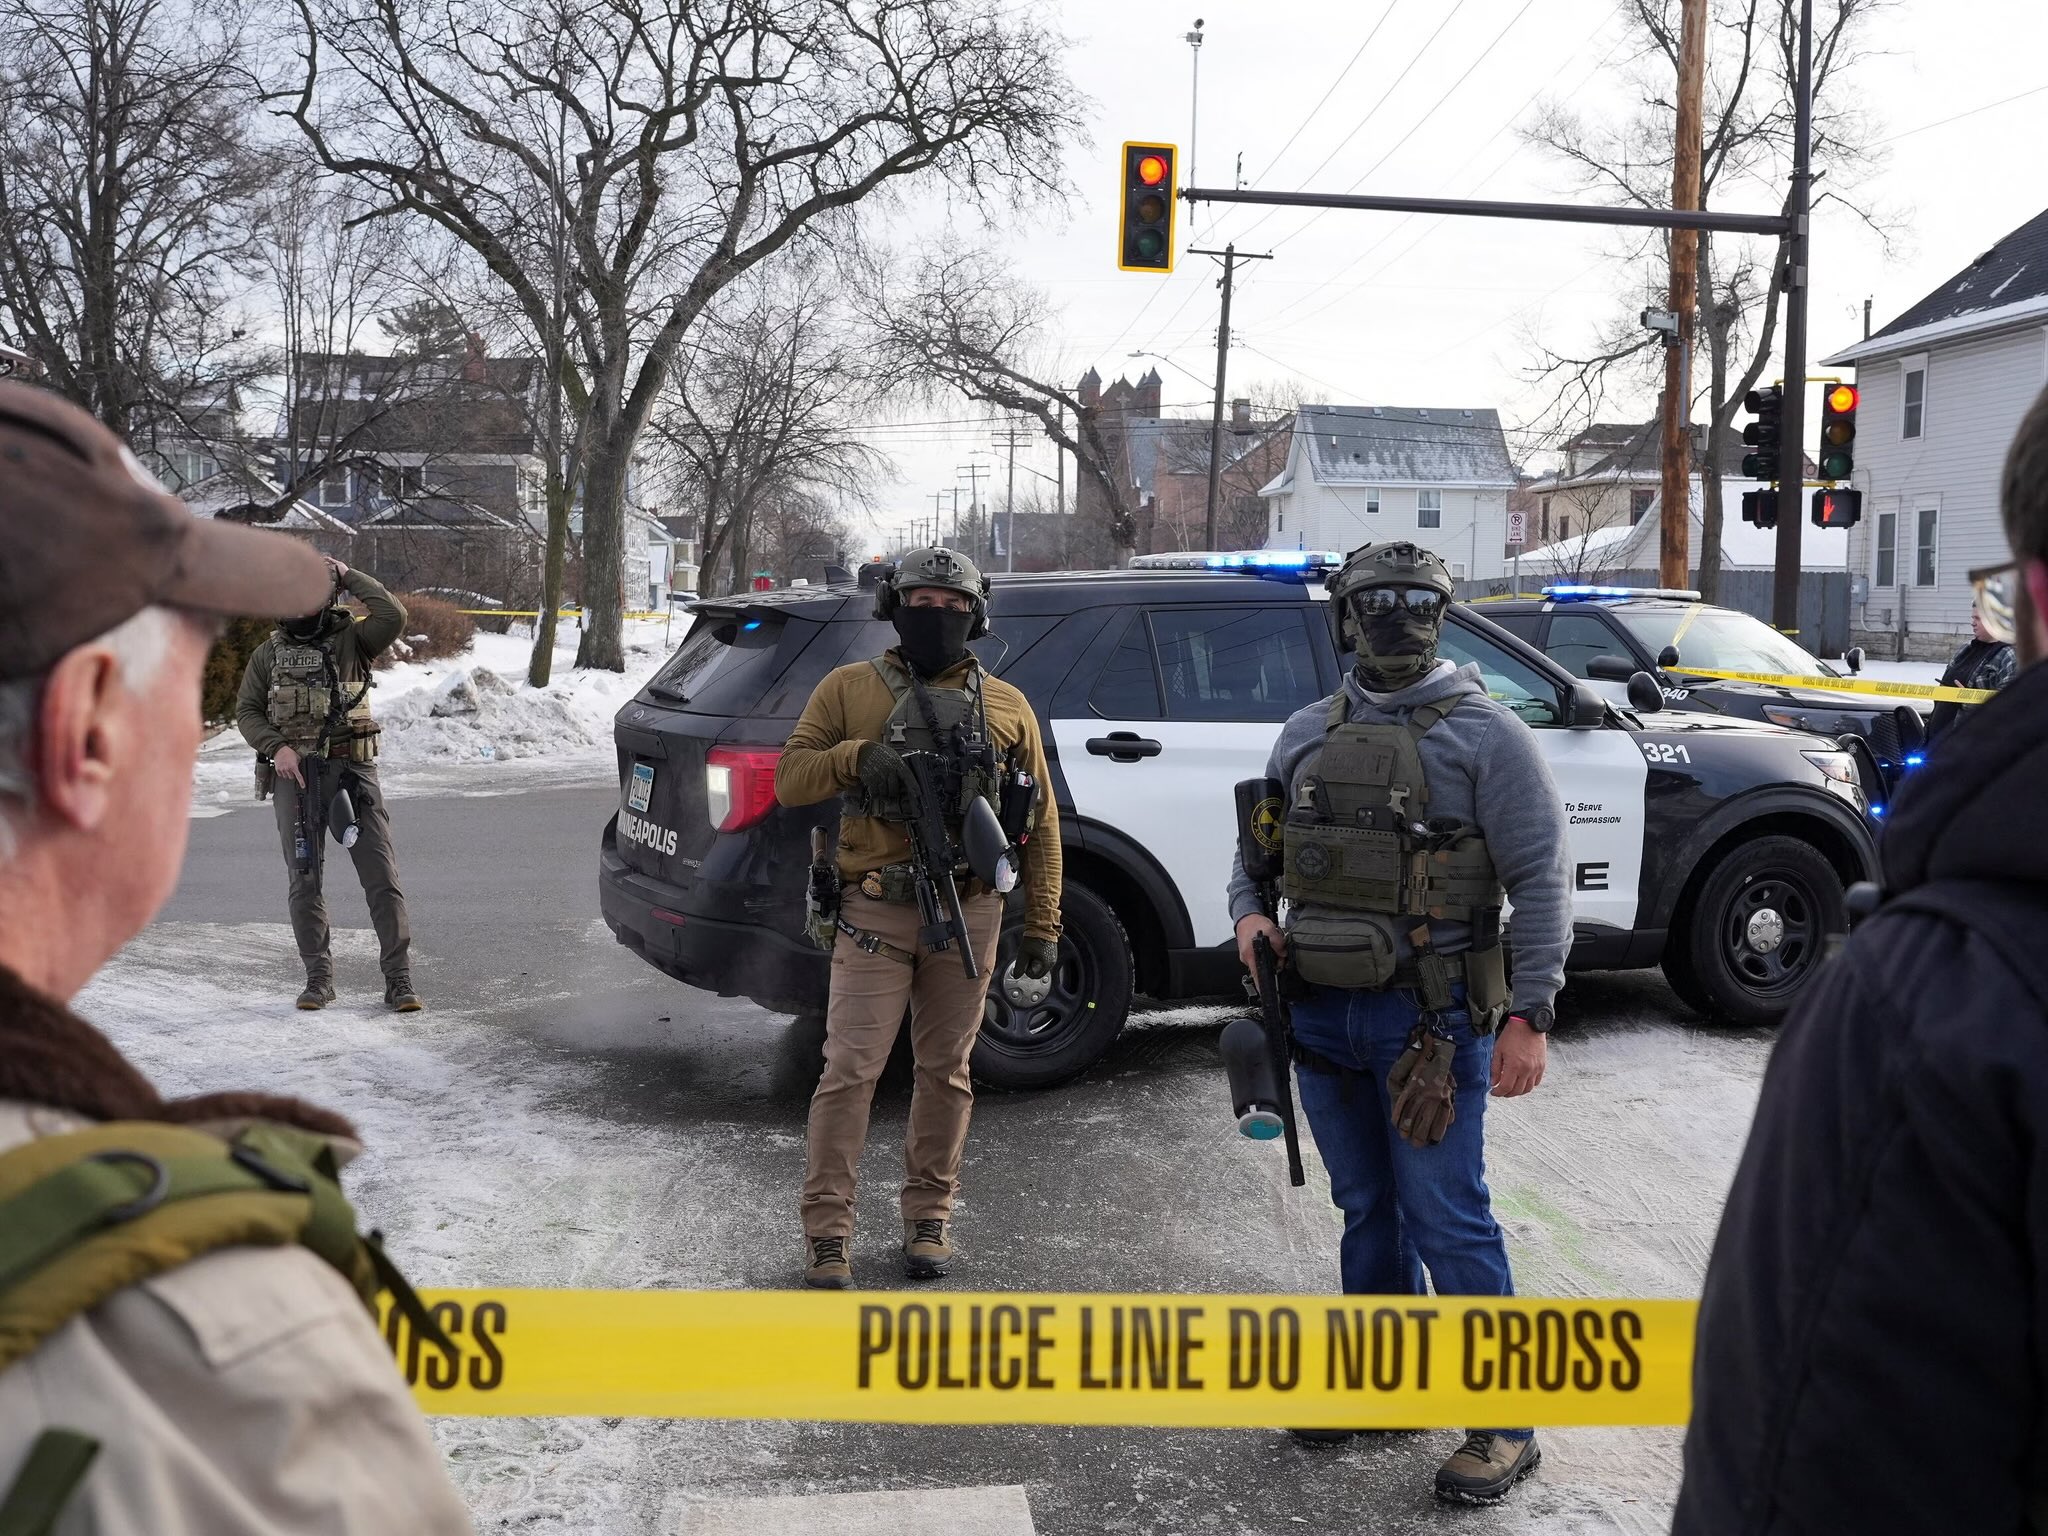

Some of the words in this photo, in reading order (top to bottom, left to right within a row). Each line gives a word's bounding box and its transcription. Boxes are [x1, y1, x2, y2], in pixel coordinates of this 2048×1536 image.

[281, 655, 317, 666] POLICE
[1661, 687, 1689, 701] 340
[1642, 742, 1692, 764] 321
[378, 1299, 506, 1391] OSS
[858, 1304, 1055, 1391] POLICE
[1079, 1305, 1205, 1391] LINE
[1228, 1307, 1299, 1392] DO
[1325, 1308, 1439, 1392] NOT
[1463, 1308, 1642, 1392] CROSS
